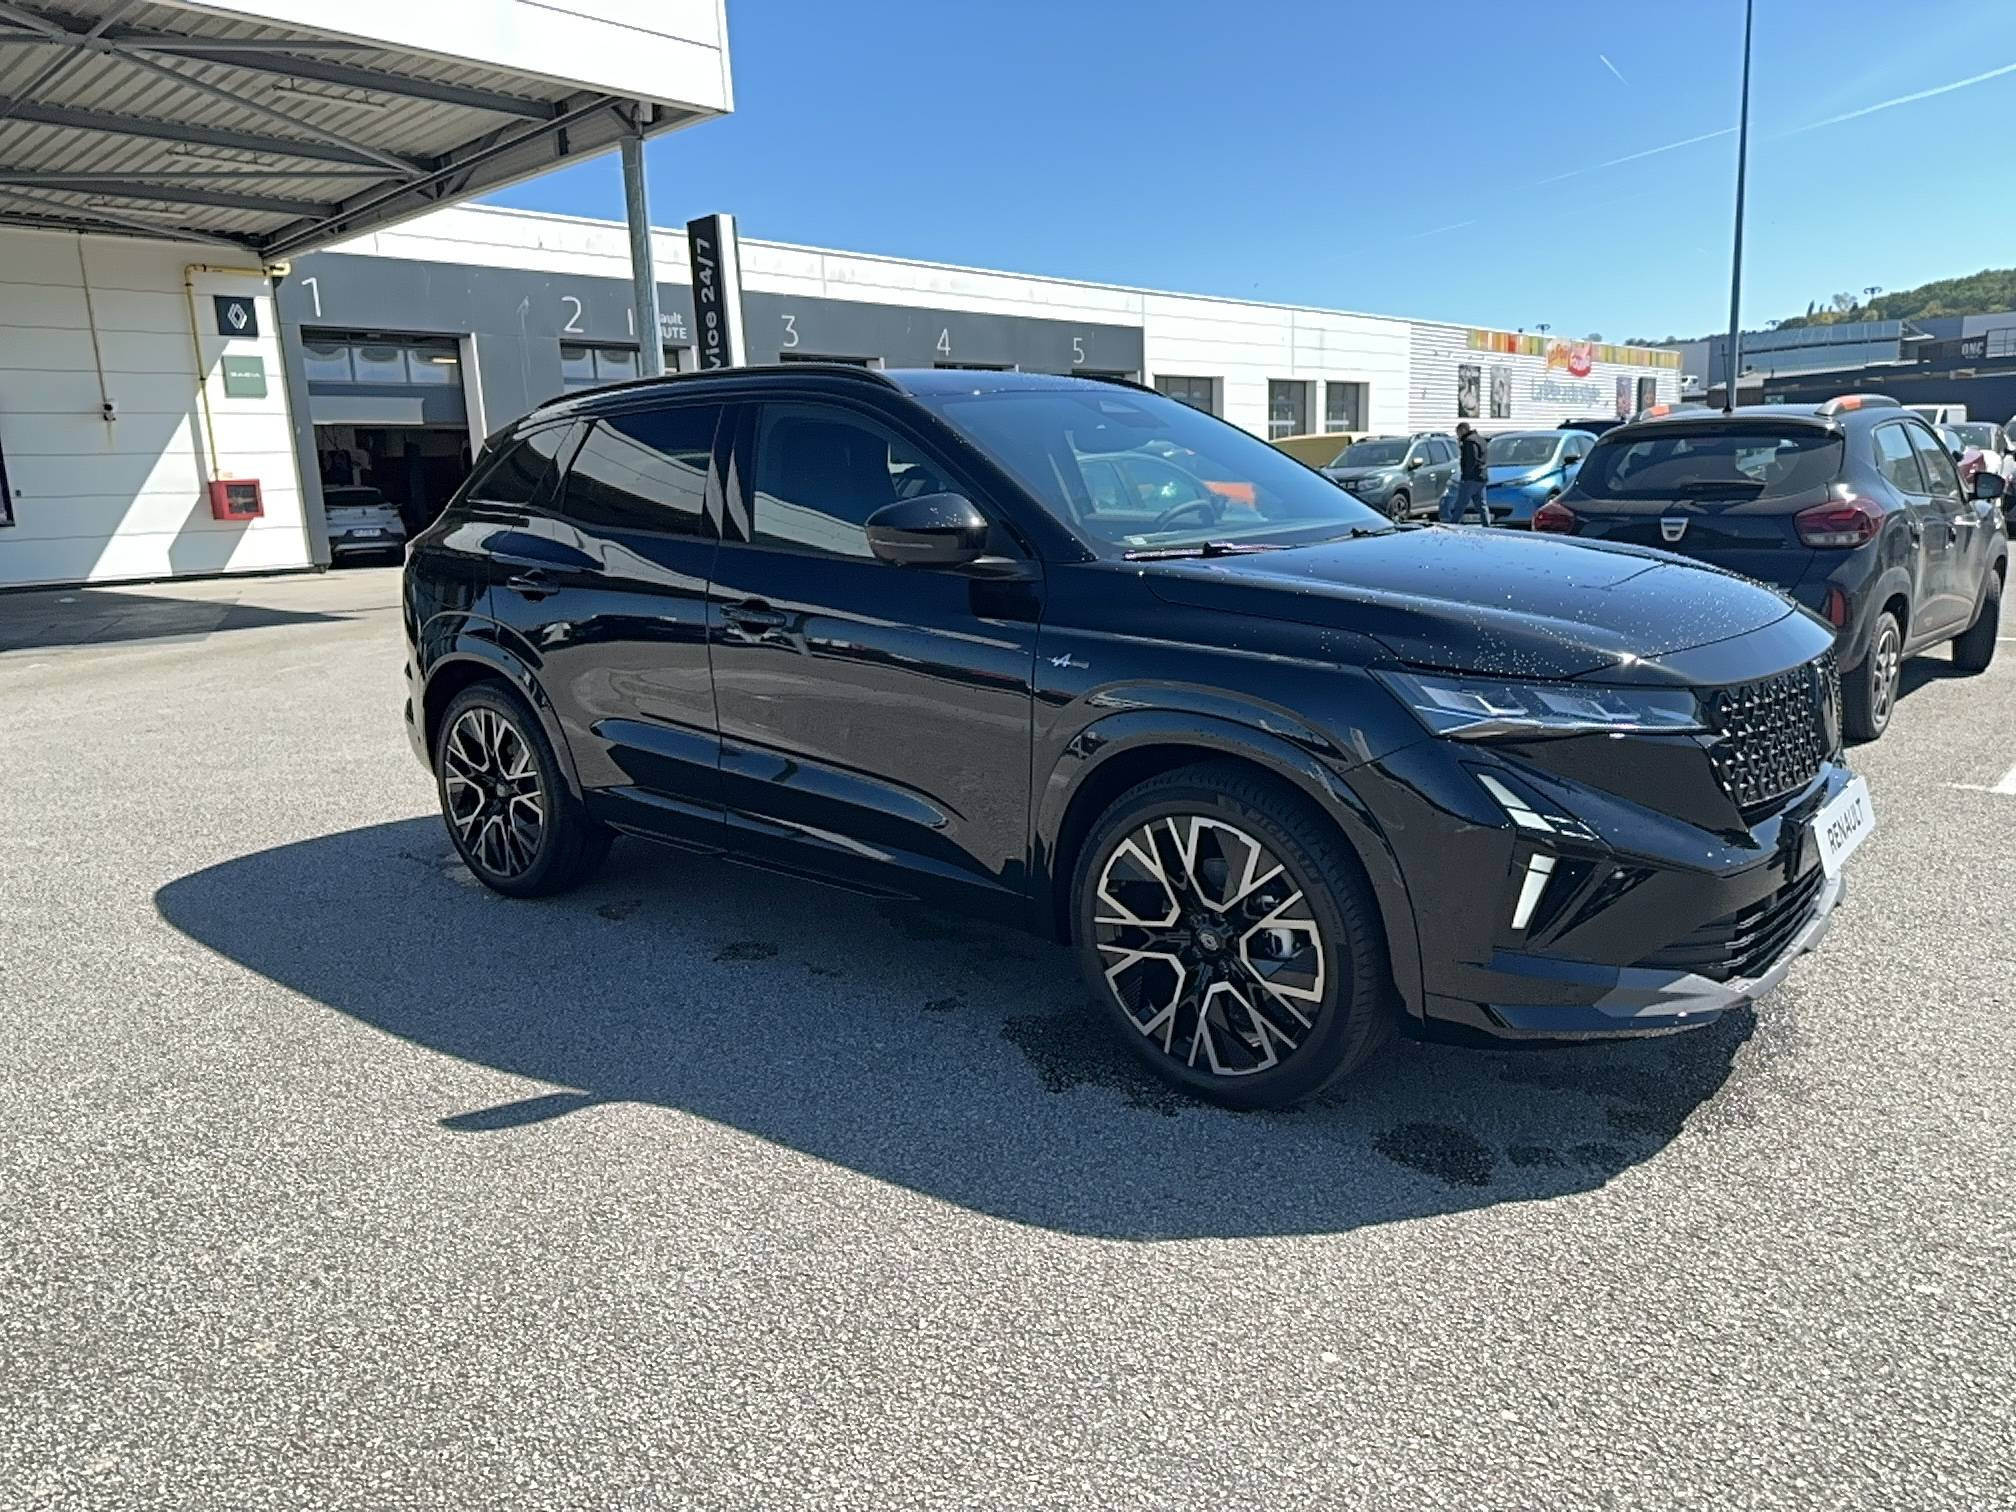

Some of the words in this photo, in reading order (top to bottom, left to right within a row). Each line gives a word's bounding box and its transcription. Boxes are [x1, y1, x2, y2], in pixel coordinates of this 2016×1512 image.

[696, 238, 715, 304] 24/7
[302, 278, 321, 317] 1
[562, 296, 585, 333] 2
[660, 312, 683, 325] ault
[662, 327, 687, 339] UTE
[781, 315, 799, 348] 3
[705, 311, 721, 371] vice
[936, 328, 951, 356] 4
[1073, 337, 1084, 363] 5
[1827, 798, 1864, 855] RENAULT
